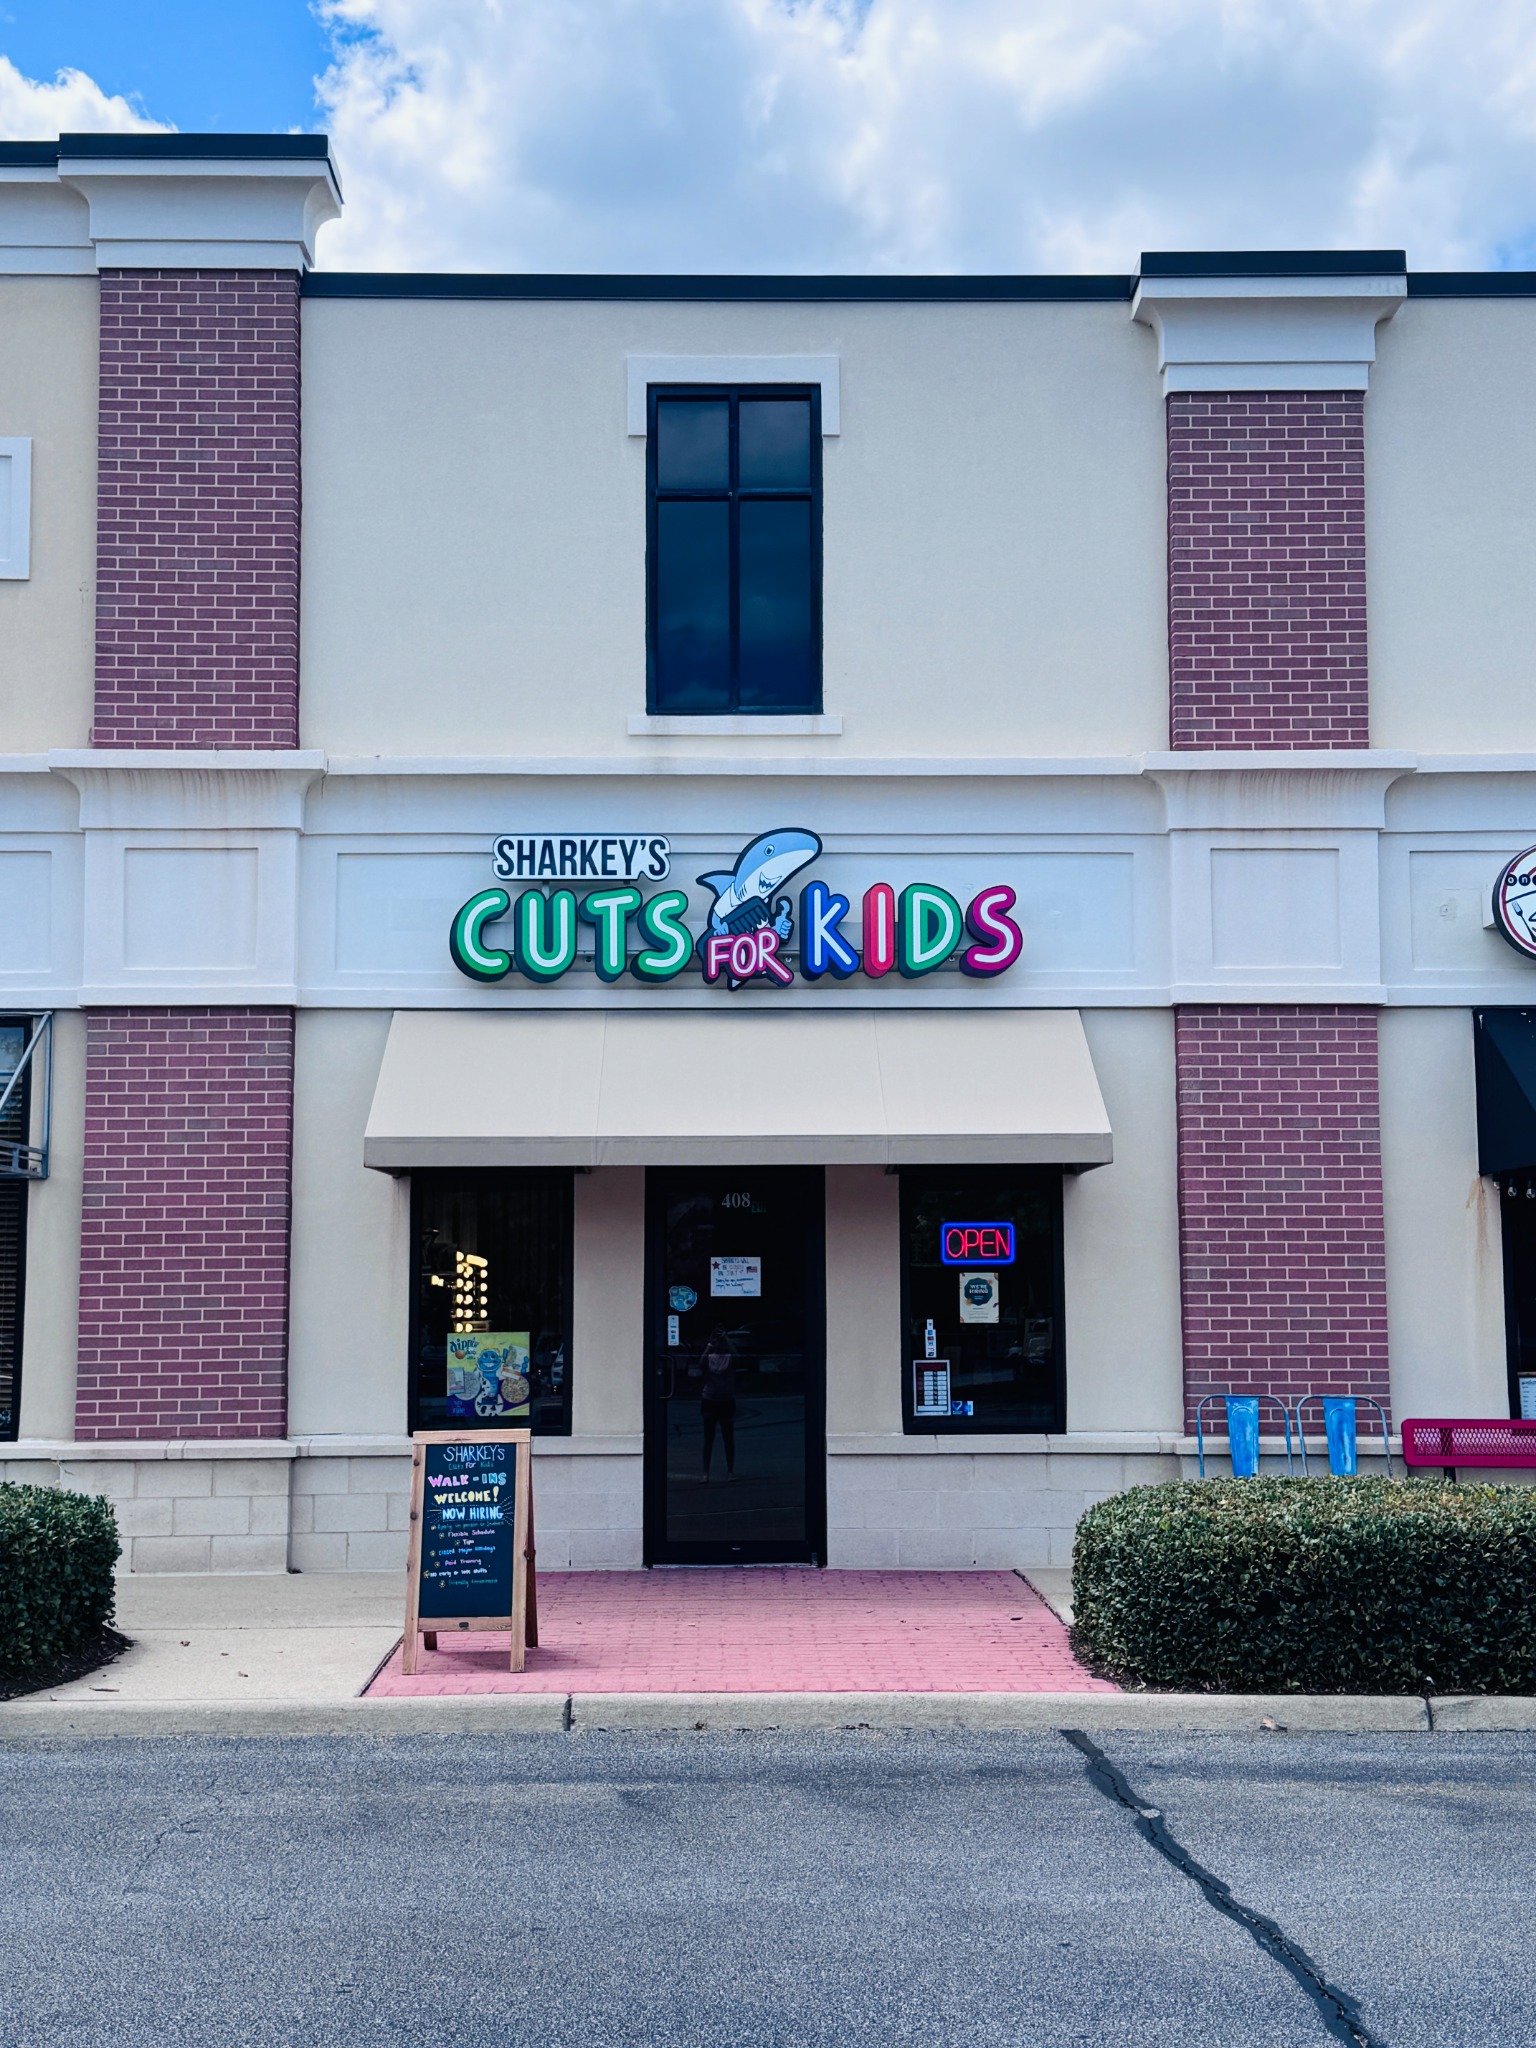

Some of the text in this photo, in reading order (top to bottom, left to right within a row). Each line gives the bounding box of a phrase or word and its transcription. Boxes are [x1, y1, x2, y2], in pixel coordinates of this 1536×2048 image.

[497, 839, 667, 876] SHARKEY'S
[450, 880, 1023, 986] CUTS FOR KIDS
[721, 1191, 751, 1209] 408
[946, 1228, 1010, 1258] OPEN
[427, 1474, 469, 1488] WALK
[481, 1472, 507, 1486] INS
[442, 1506, 504, 1520] NOW HIRING
